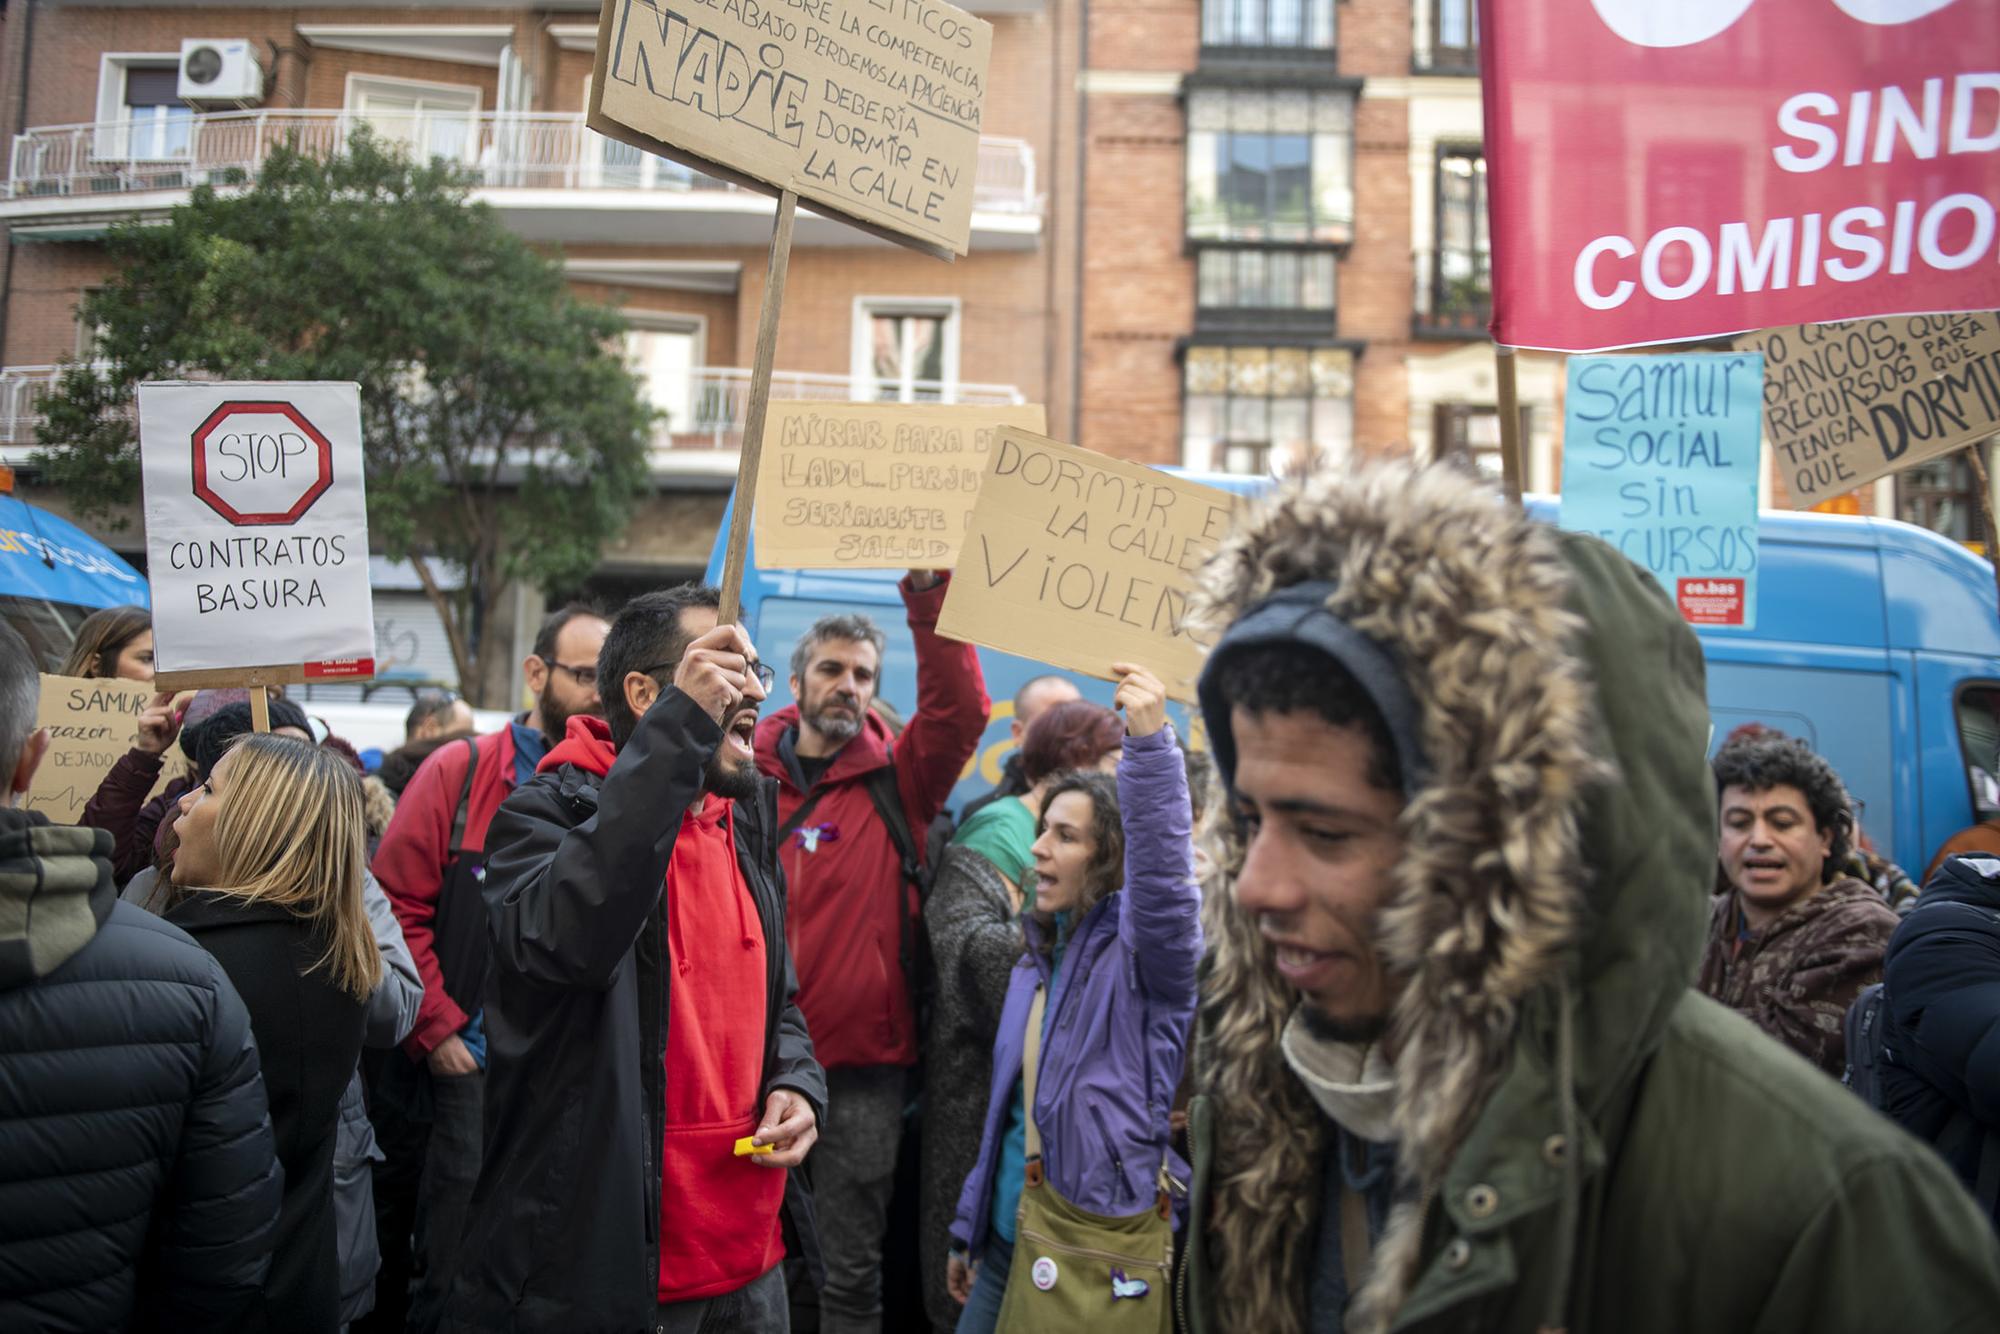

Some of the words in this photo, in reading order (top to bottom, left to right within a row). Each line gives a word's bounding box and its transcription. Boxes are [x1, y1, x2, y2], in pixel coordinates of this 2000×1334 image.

[840, 10, 860, 36] LA
[888, 71, 908, 94] LA
[1773, 72, 2000, 173] SIND
[803, 149, 838, 186] LA
[849, 166, 945, 222] CALLE
[922, 157, 959, 189] EN
[1573, 193, 2000, 310] COMISIO
[1922, 319, 1986, 358] PARA
[1931, 343, 1977, 372] QUE
[1767, 354, 1917, 439] RECURSOS
[893, 422, 962, 454] PARA
[1779, 414, 1871, 464] TENGA
[219, 432, 308, 482] STOP
[1796, 453, 1857, 495] QUE
[1046, 504, 1089, 544] LA
[1108, 523, 1201, 572] CALLE
[1201, 505, 1232, 541] E
[170, 535, 346, 570] CONTRATOS
[834, 534, 950, 561] SALUD
[196, 578, 327, 614] BASURA
[67, 689, 147, 716] SAMUR
[54, 751, 114, 767] DEJADO
